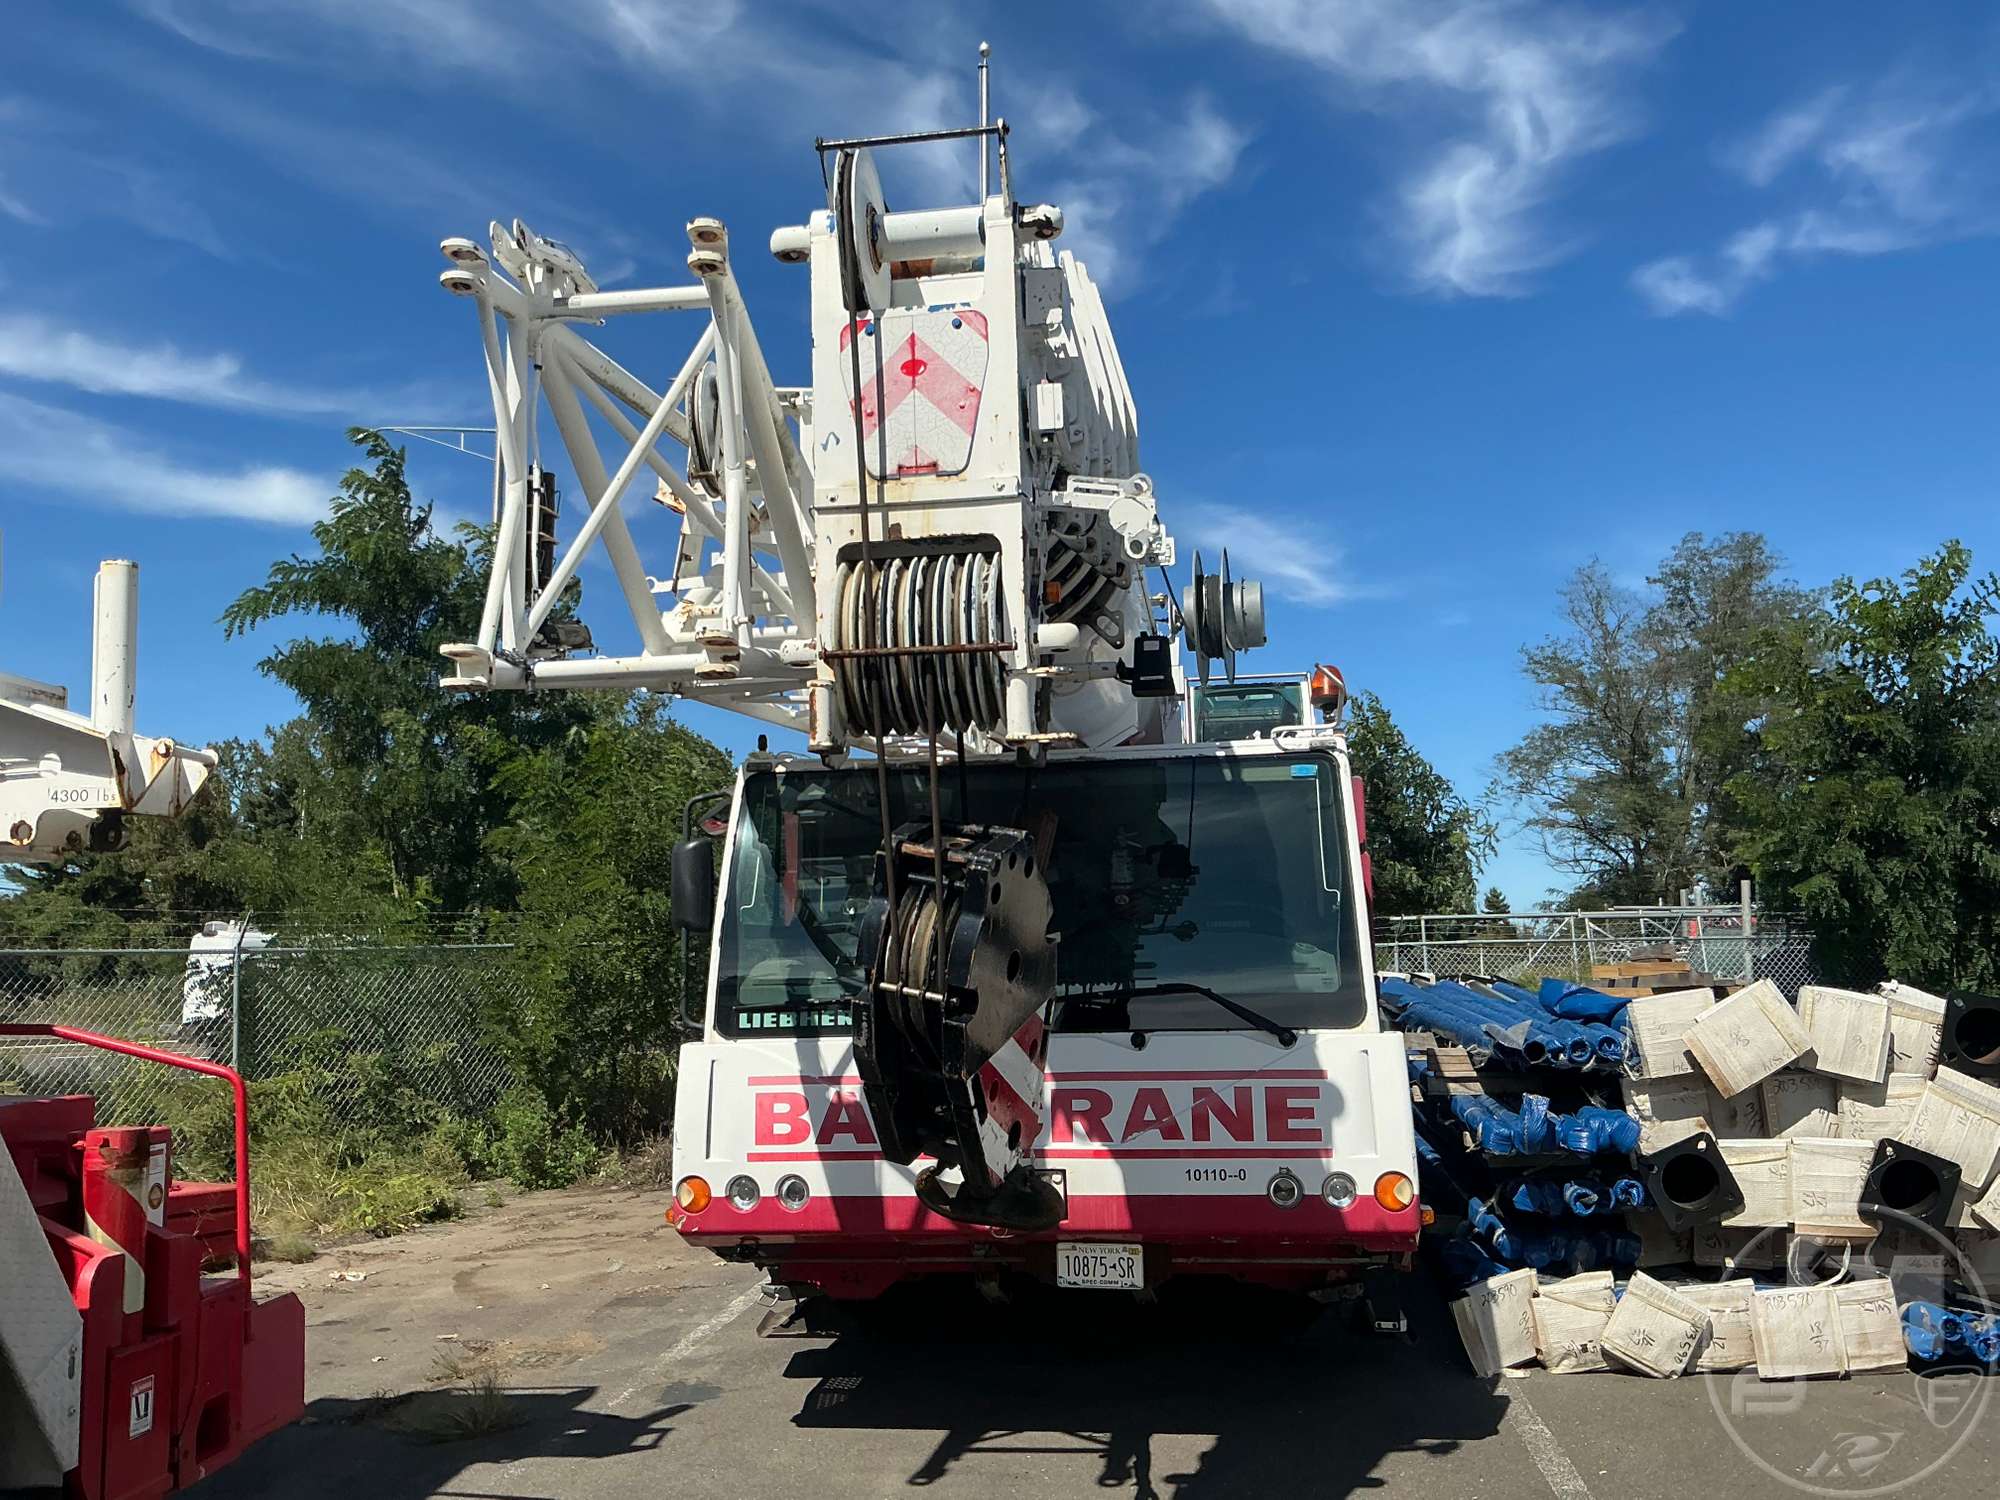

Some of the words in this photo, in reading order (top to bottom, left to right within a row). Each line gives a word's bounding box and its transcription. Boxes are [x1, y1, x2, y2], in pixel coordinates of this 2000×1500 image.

[739, 1010, 852, 1028] LIEBHER
[755, 1091, 877, 1146] BA
[1050, 1086, 1322, 1143] RANE
[1078, 1246, 1098, 1255] NEW
[1099, 1247, 1121, 1255] YORK
